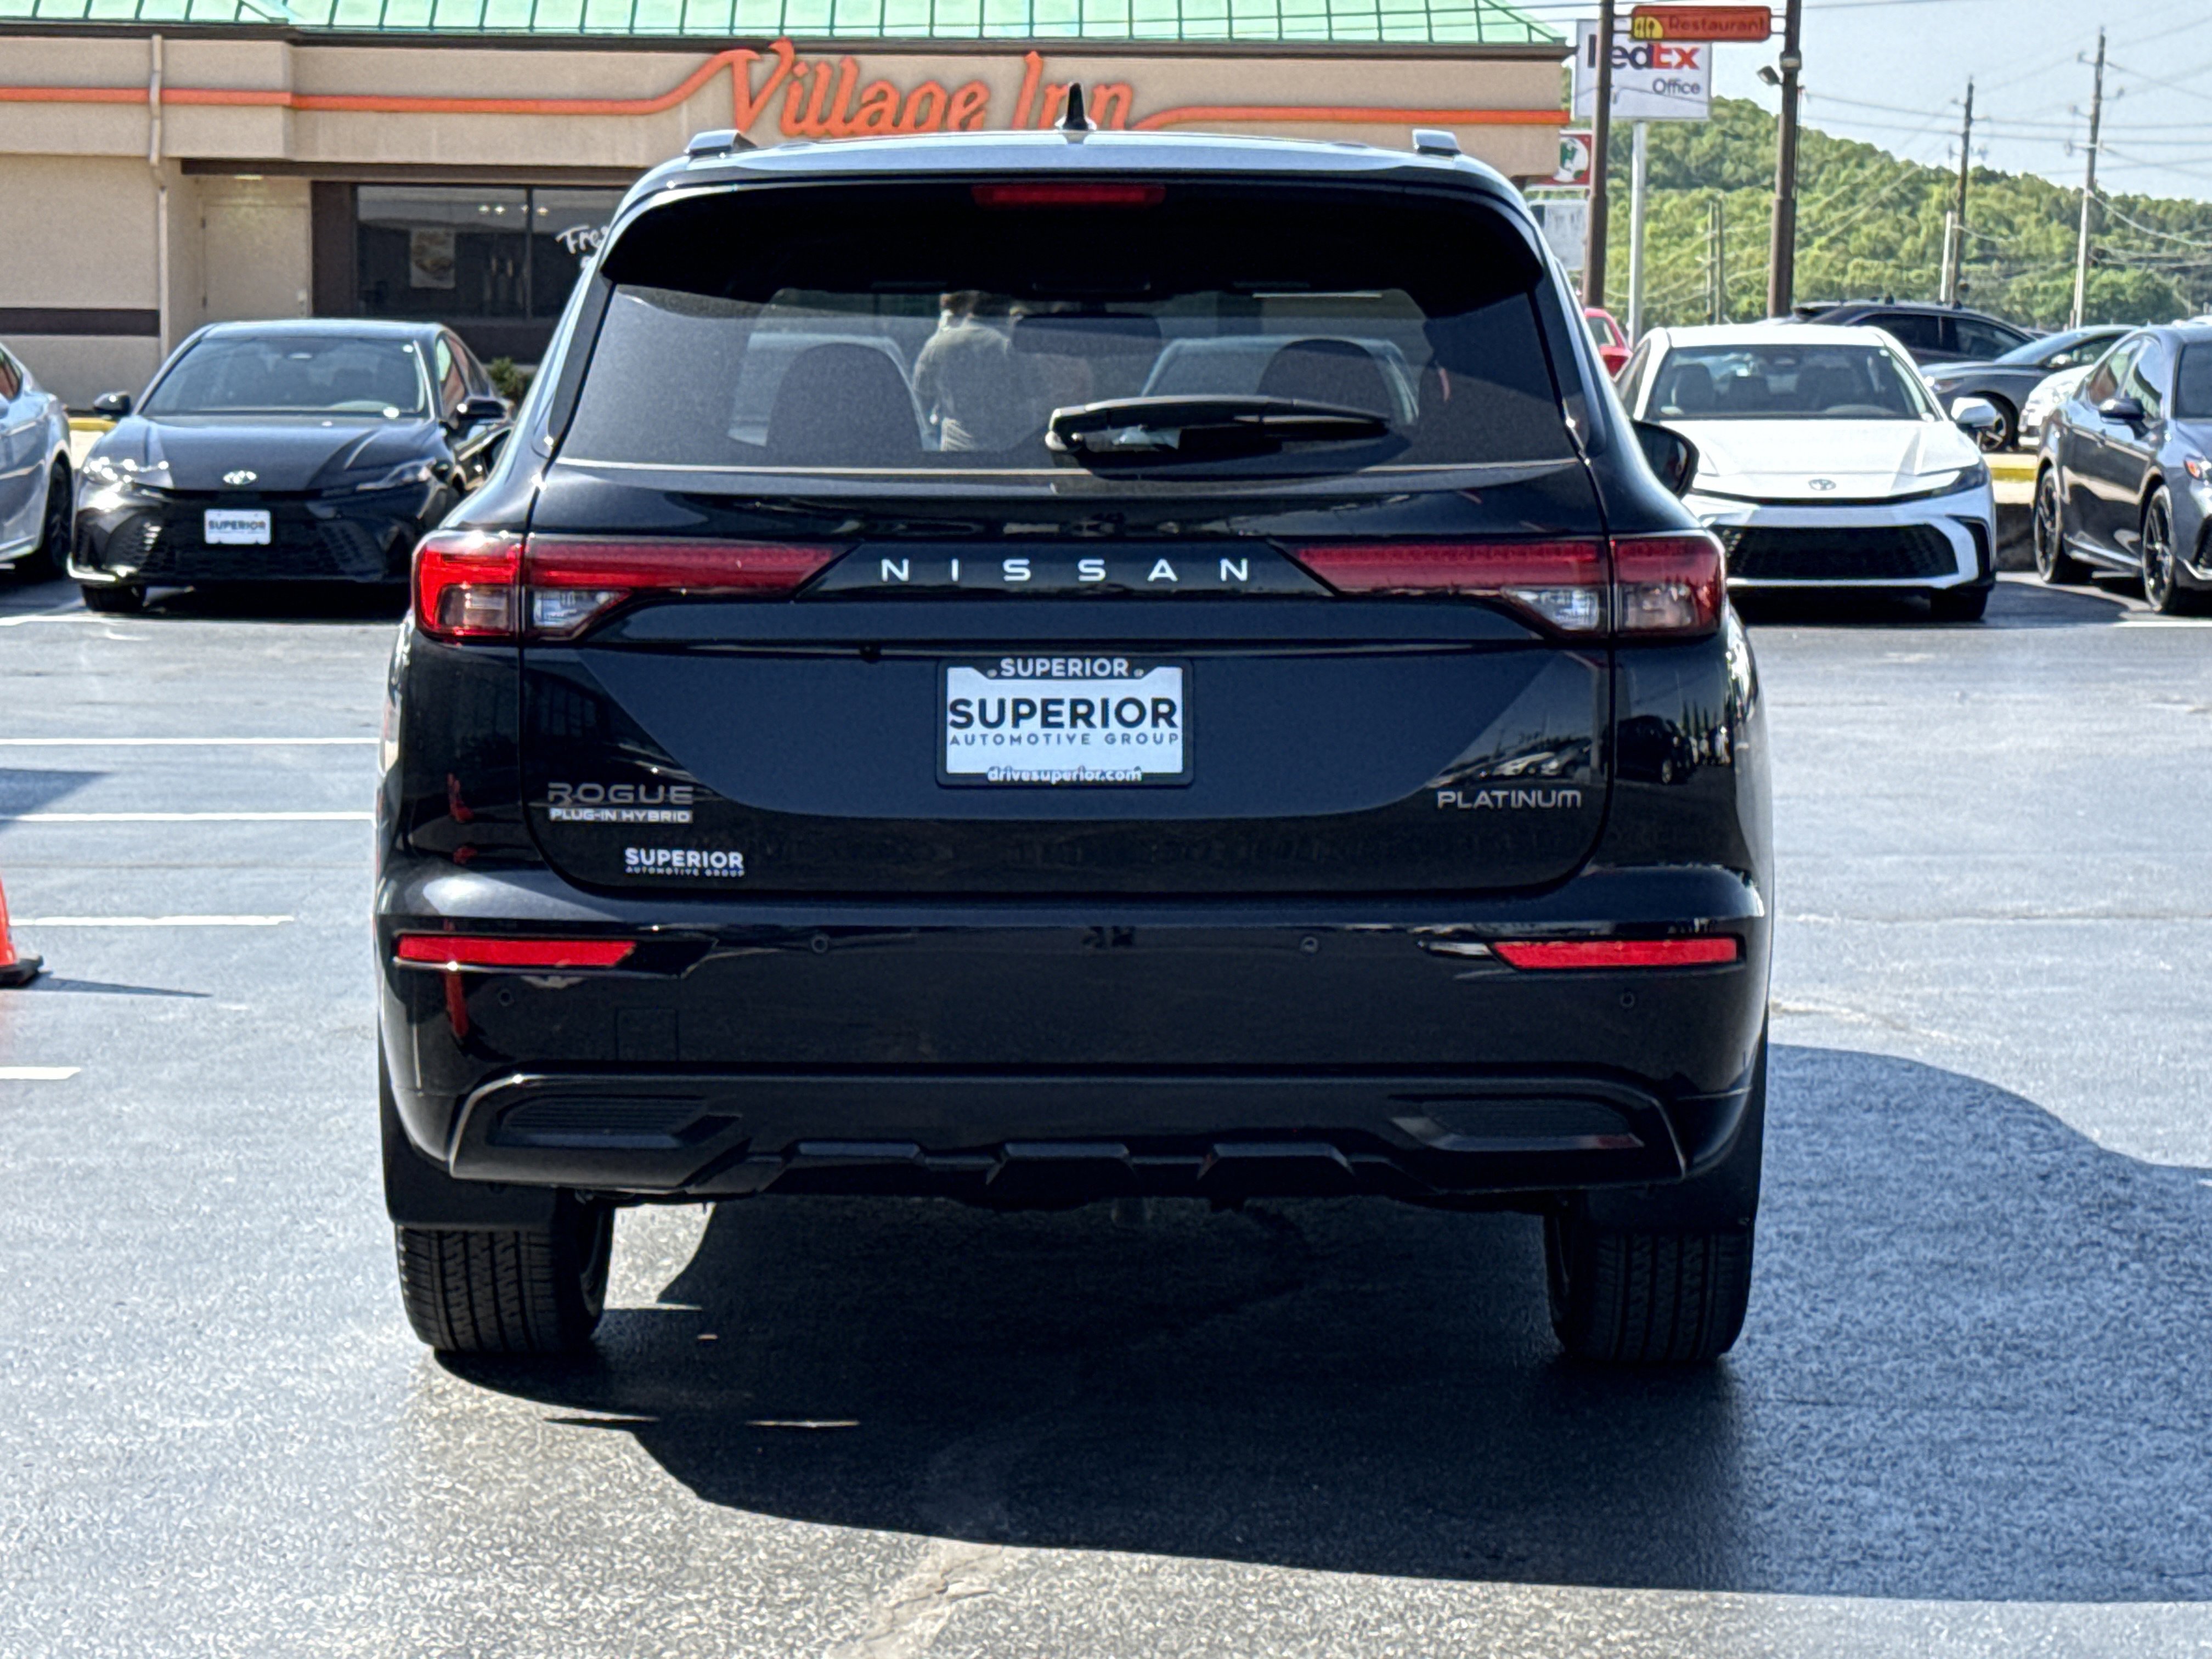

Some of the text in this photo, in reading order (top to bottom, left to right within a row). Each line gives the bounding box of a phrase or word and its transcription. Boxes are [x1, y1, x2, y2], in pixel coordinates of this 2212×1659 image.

[1668, 16, 1766, 32] Restaurant
[724, 36, 991, 138] Village
[1652, 78, 1701, 95] Office
[881, 558, 1249, 582] NISSAN
[1001, 658, 1130, 678] SUPERIOR
[949, 697, 1179, 729] SUPERIOR
[950, 733, 1179, 746] AUTOMOTIVE GROUP
[988, 766, 1143, 785] drivesuperior.com
[548, 782, 693, 807] ROGUE
[1437, 789, 1581, 809] PLATINUM
[550, 808, 691, 823] PLUG-IN HYBRID
[625, 848, 743, 868] SUPERIOR
